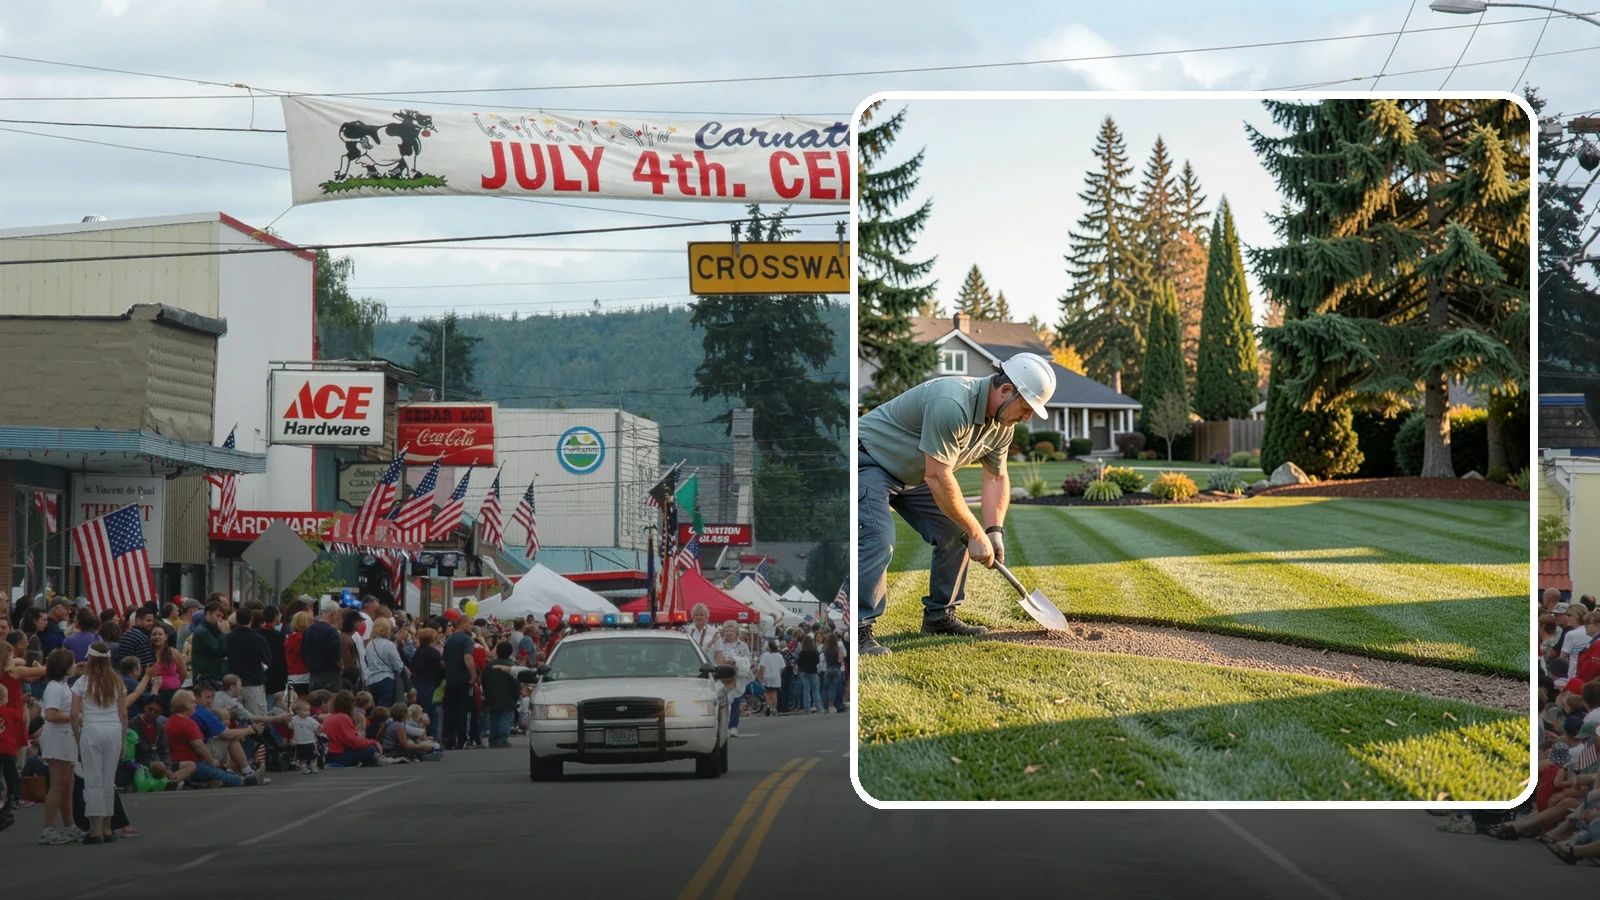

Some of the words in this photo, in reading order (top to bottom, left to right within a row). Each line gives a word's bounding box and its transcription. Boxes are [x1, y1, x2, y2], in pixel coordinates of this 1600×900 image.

[481, 141, 604, 192] JULY
[632, 150, 746, 198] 4th.
[697, 254, 850, 280] CROSSWA
[283, 380, 373, 420] ACE
[406, 409, 452, 422] CEDAR
[461, 409, 485, 422] LOG
[283, 421, 370, 436] Hardware
[416, 428, 476, 446] Coca-Cola
[353, 467, 385, 480] Simpl
[95, 485, 124, 494] Vincent
[126, 485, 135, 494] de
[137, 486, 155, 495] Paul
[212, 516, 331, 535] HARDARE
[688, 527, 741, 536] CRNATION
